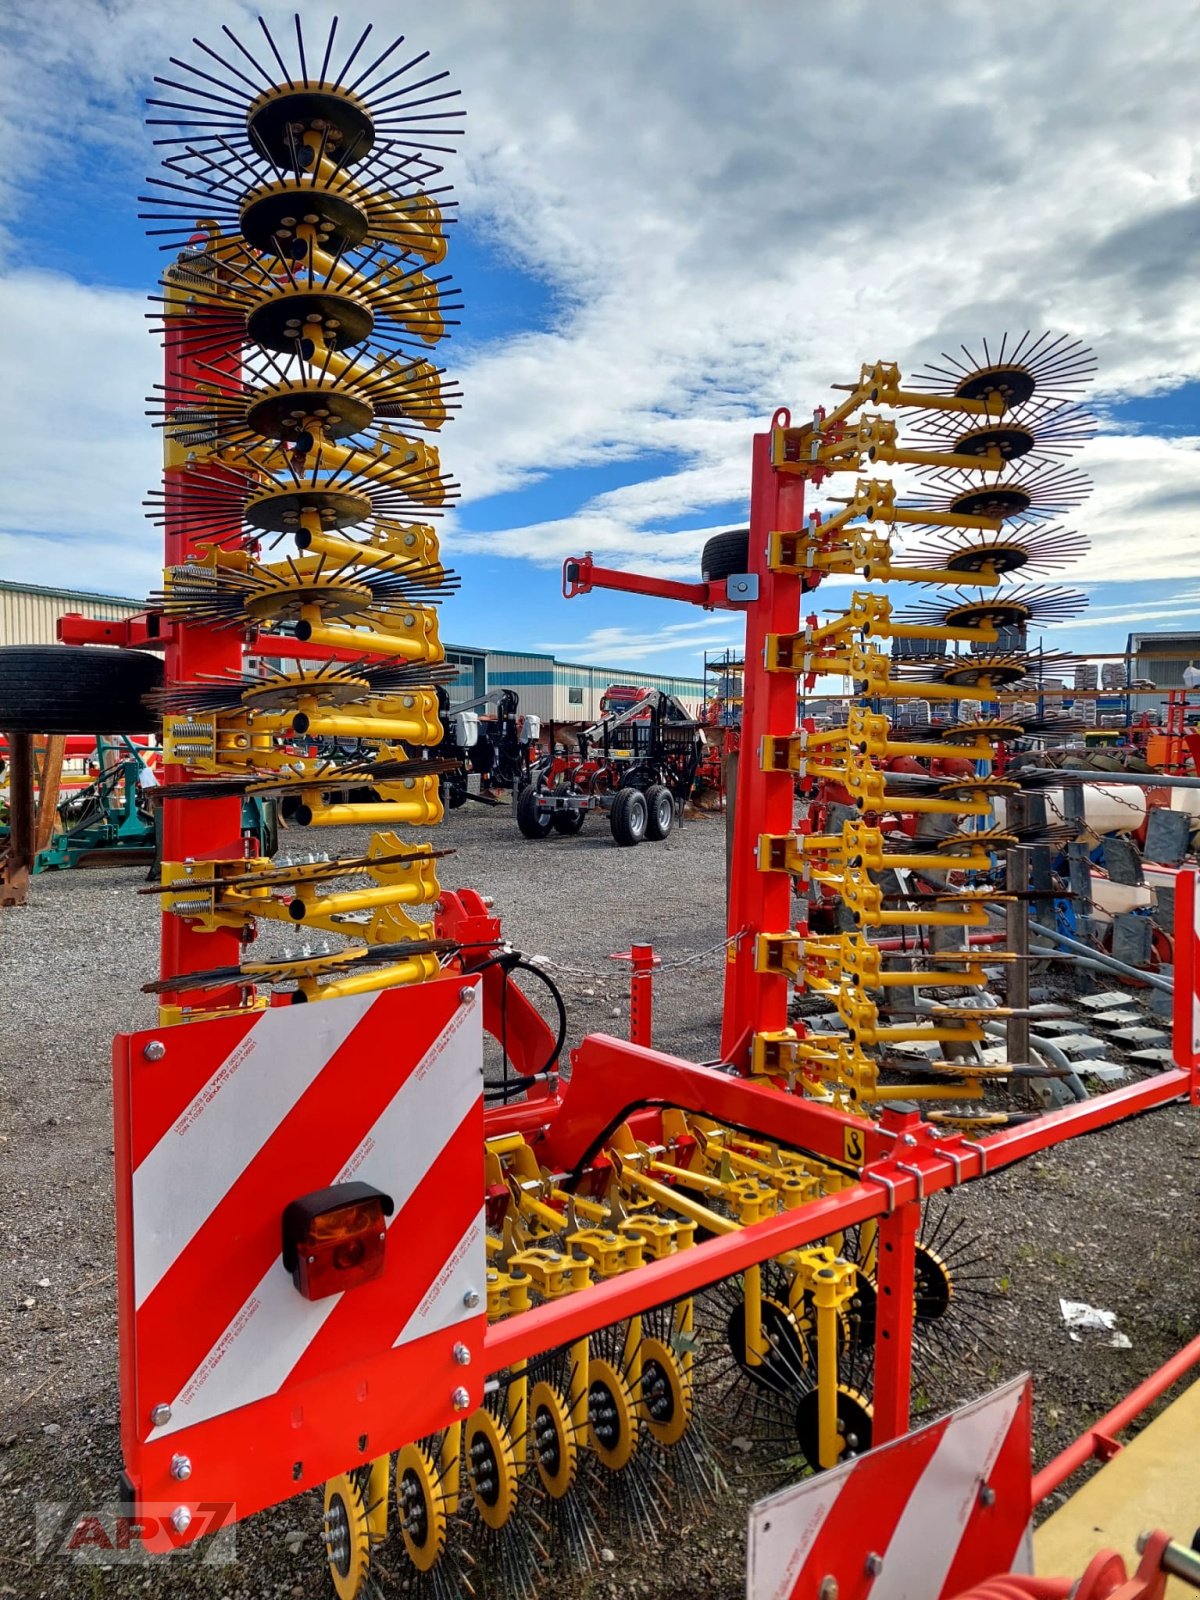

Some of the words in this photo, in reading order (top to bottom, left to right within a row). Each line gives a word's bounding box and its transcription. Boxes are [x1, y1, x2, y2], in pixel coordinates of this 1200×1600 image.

[211, 1069, 227, 1087] GEKA
[205, 1084, 222, 1103] GEKA
[216, 1332, 232, 1352] GEKA
[210, 1349, 226, 1369] GEKA
